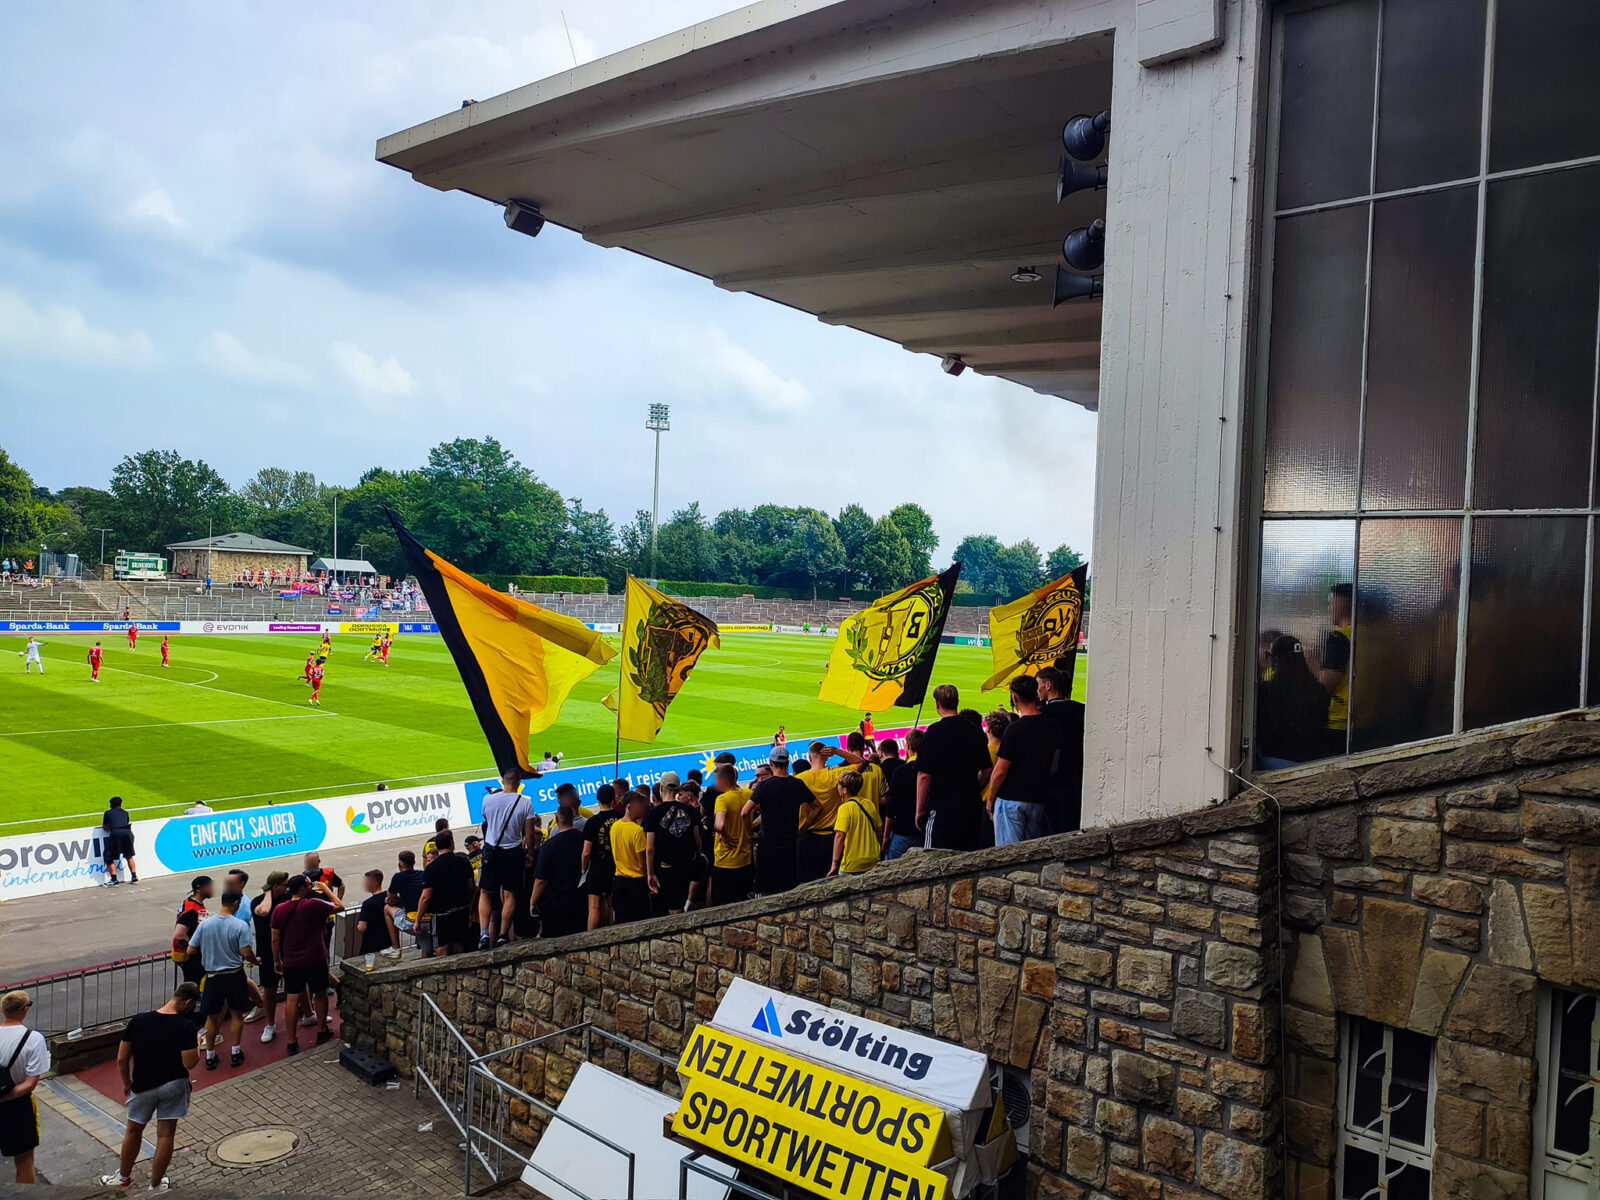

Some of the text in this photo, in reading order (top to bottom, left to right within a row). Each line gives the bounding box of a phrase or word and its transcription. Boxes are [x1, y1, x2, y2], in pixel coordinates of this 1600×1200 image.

[9, 622, 70, 630] Sparda-Bank
[103, 622, 158, 631] SpardBank
[190, 812, 297, 847] EINFACH SAUBER
[784, 1008, 934, 1081] Stölting
[684, 1033, 931, 1154] SPORTWETTEN
